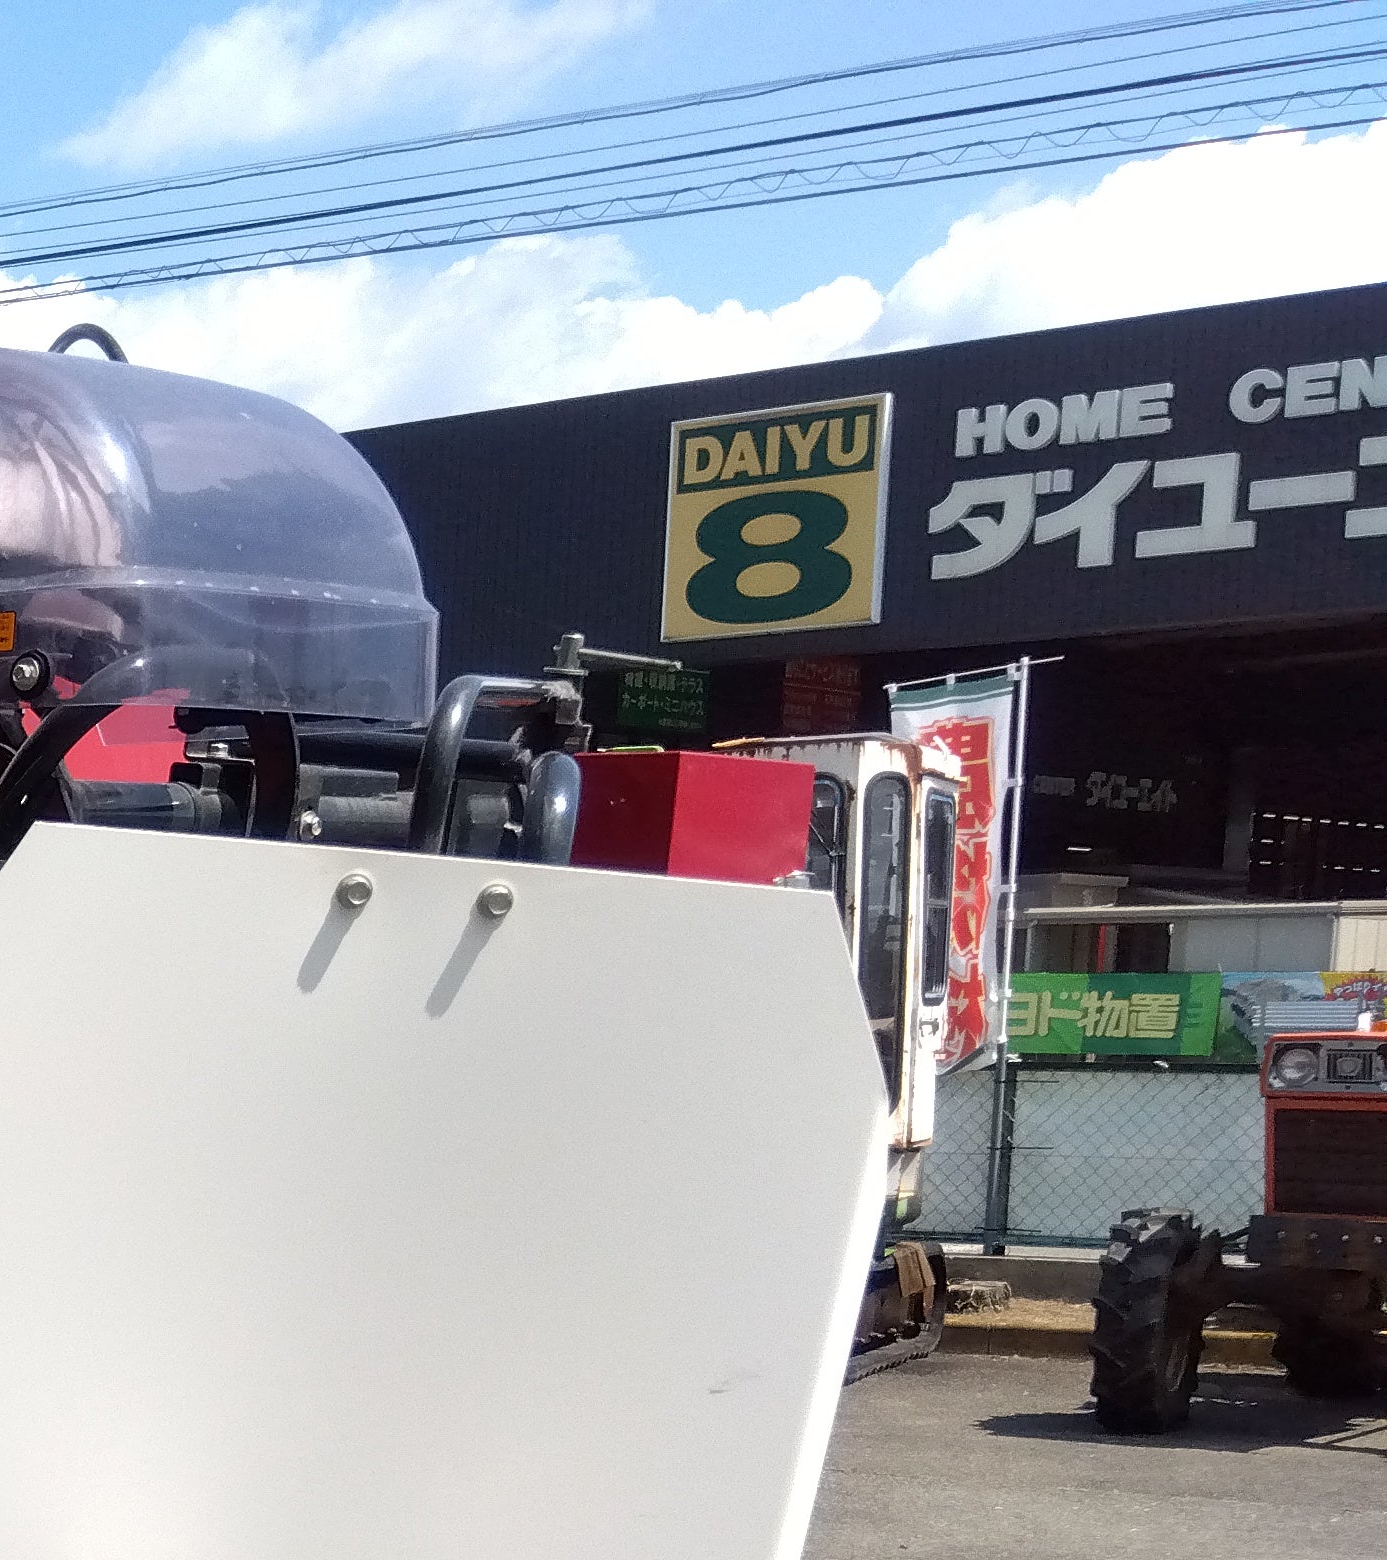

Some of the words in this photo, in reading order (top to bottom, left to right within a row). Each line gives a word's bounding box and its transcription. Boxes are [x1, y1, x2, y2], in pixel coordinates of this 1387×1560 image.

[683, 413, 870, 485] DAIYU
[954, 382, 1174, 458] HOME
[685, 488, 853, 625] 8
